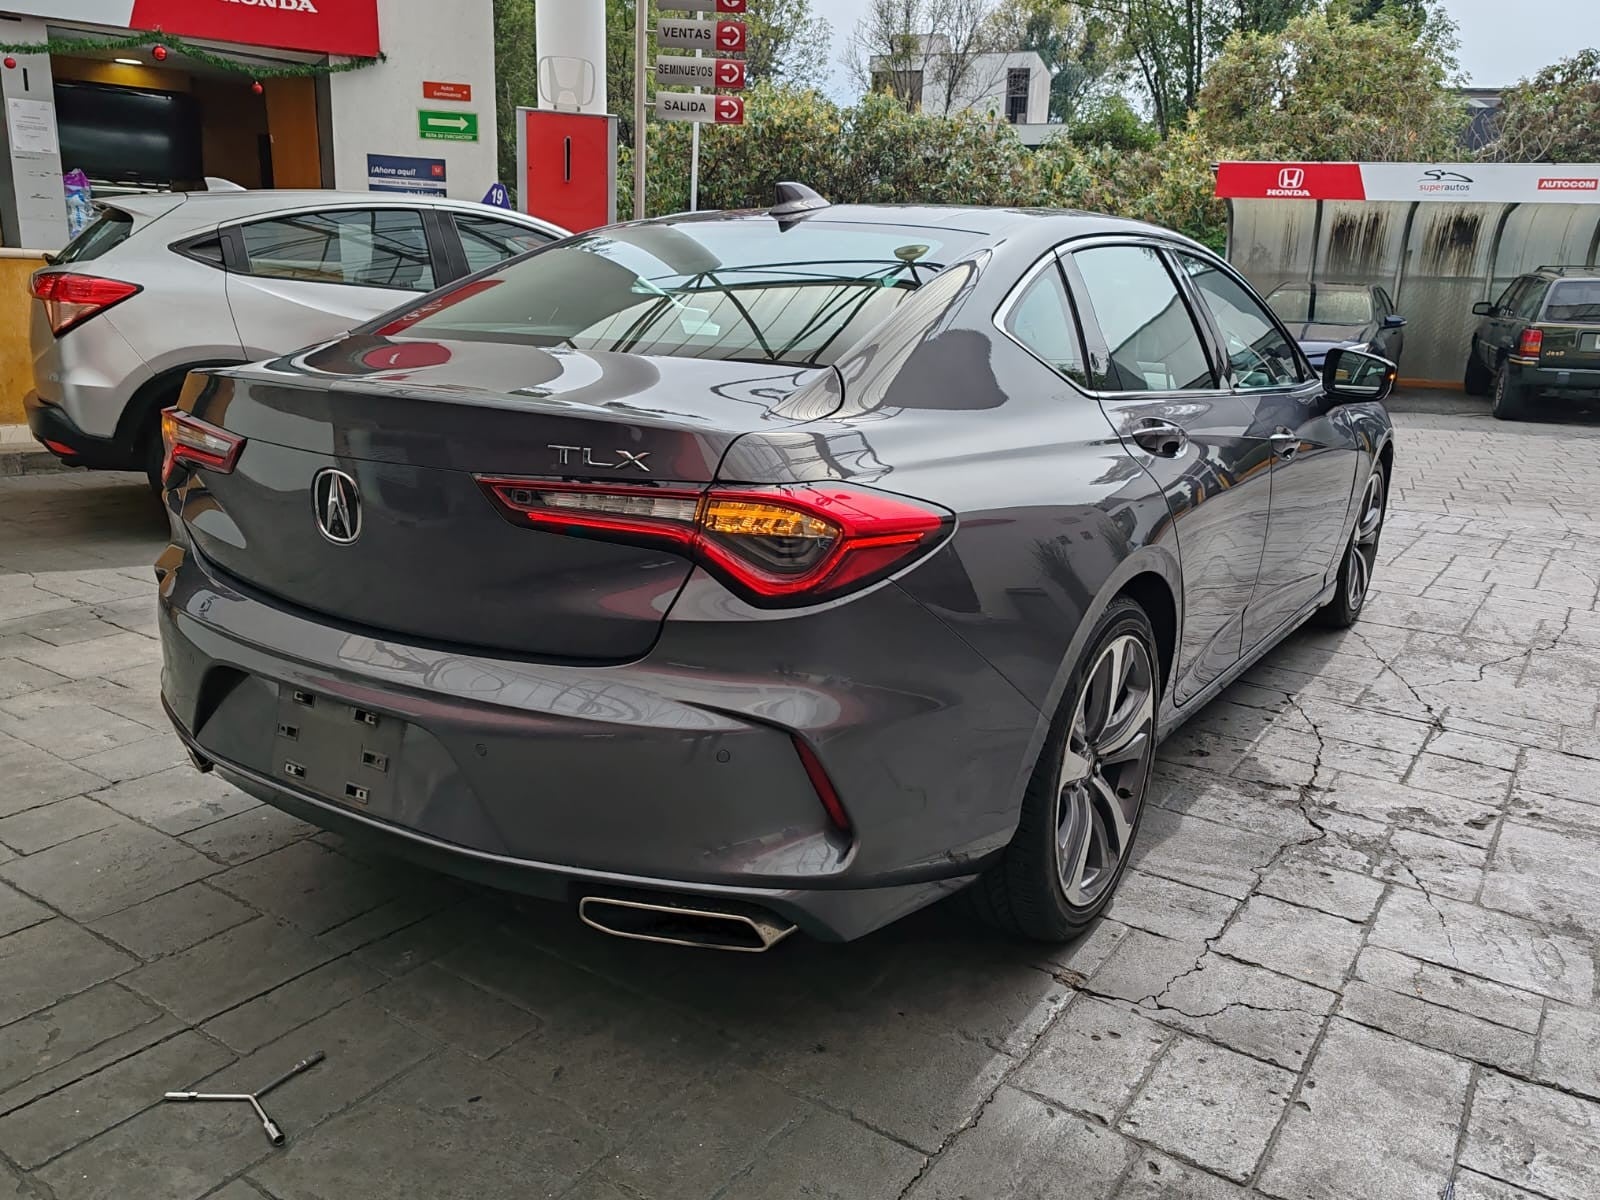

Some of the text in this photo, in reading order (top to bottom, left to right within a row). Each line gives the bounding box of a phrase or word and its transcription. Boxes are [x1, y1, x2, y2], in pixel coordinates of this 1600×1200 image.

[662, 27, 712, 39] VENTAS
[658, 64, 713, 77] SEMINUEVOS
[664, 100, 706, 112] SALIDA
[371, 166, 396, 175] ¡Ahora
[1419, 184, 1470, 192] superautos
[1540, 180, 1596, 188] AUTOCOM
[491, 188, 503, 205] 19
[547, 444, 651, 472] TLX
